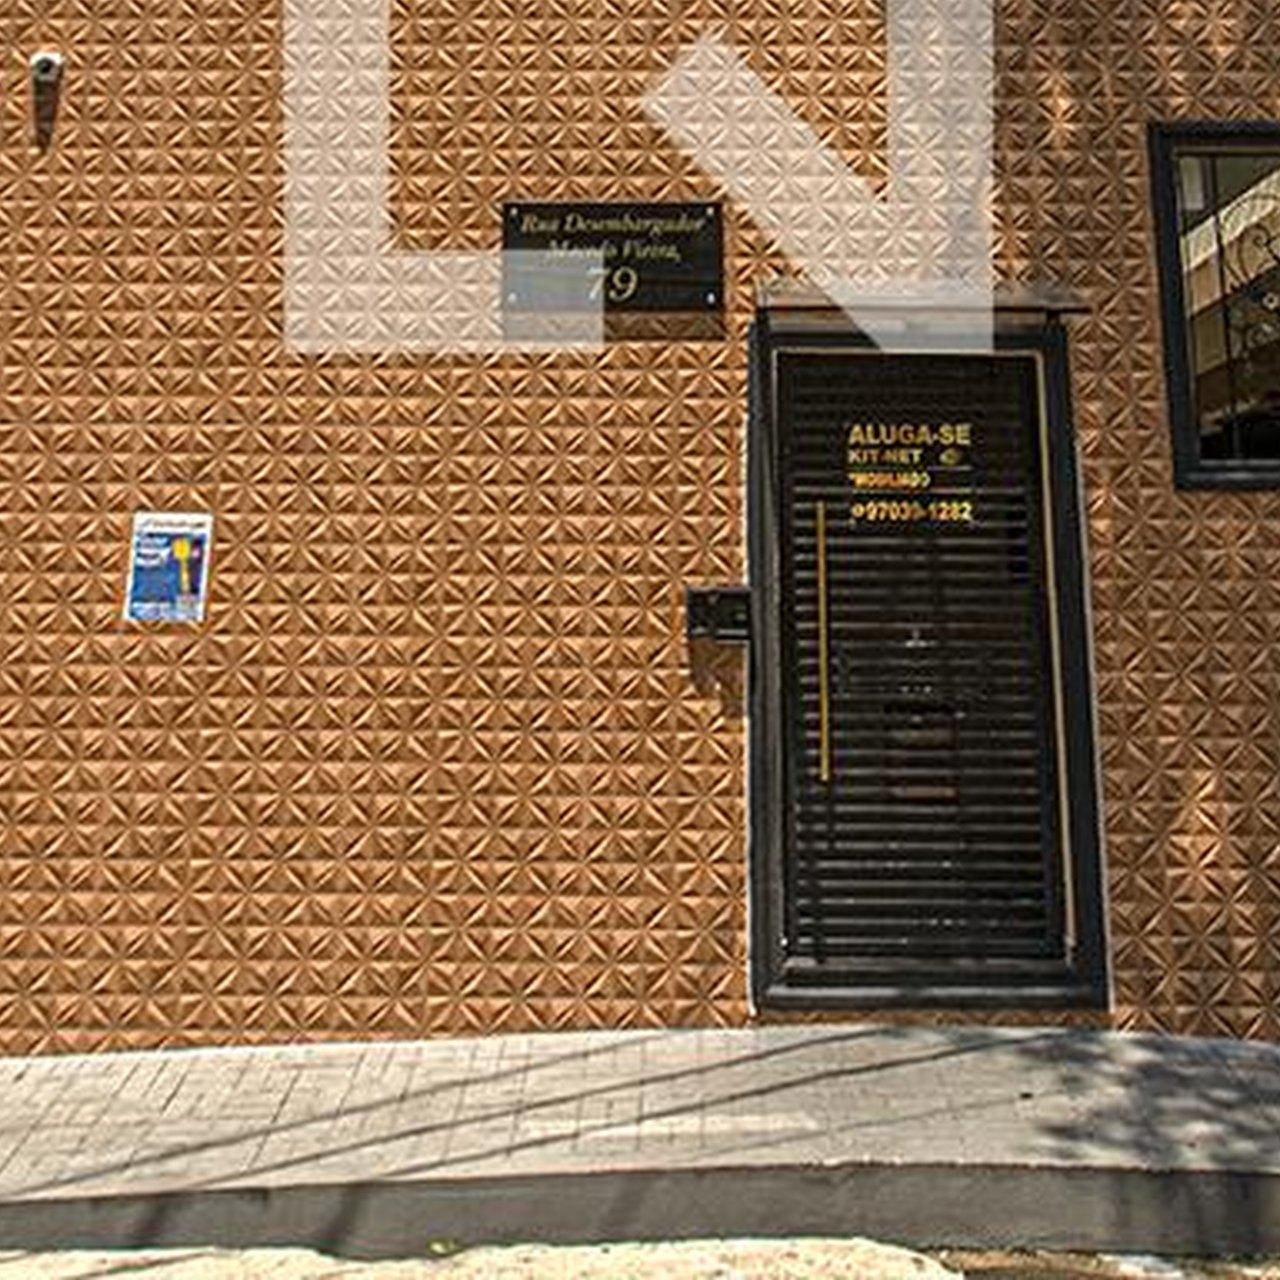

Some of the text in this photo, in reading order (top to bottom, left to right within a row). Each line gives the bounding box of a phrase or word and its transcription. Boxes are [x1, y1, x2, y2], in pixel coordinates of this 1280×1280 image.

[520, 214, 559, 233] Rua
[586, 267, 639, 302] 79
[847, 423, 972, 447] ALUGA-SE
[847, 448, 924, 465] KIT-NET
